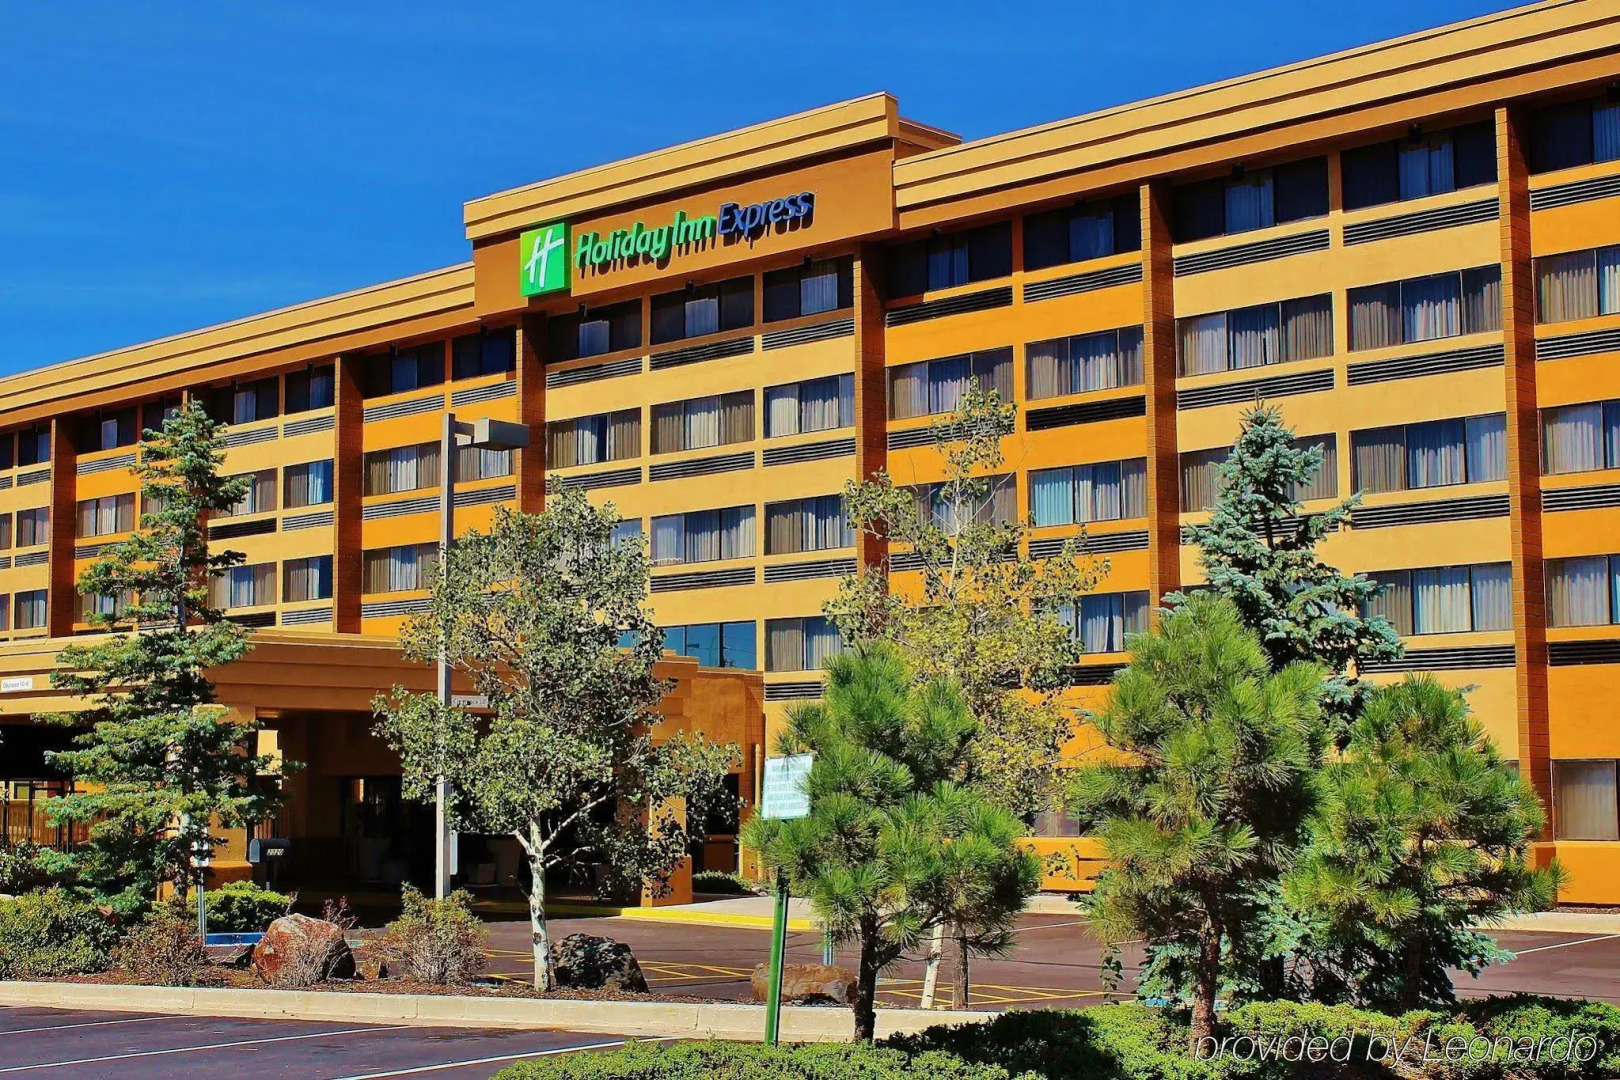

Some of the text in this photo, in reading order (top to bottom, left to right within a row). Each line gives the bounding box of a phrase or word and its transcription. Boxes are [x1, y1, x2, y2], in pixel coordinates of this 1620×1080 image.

[575, 191, 816, 268] Holiday Inn Express
